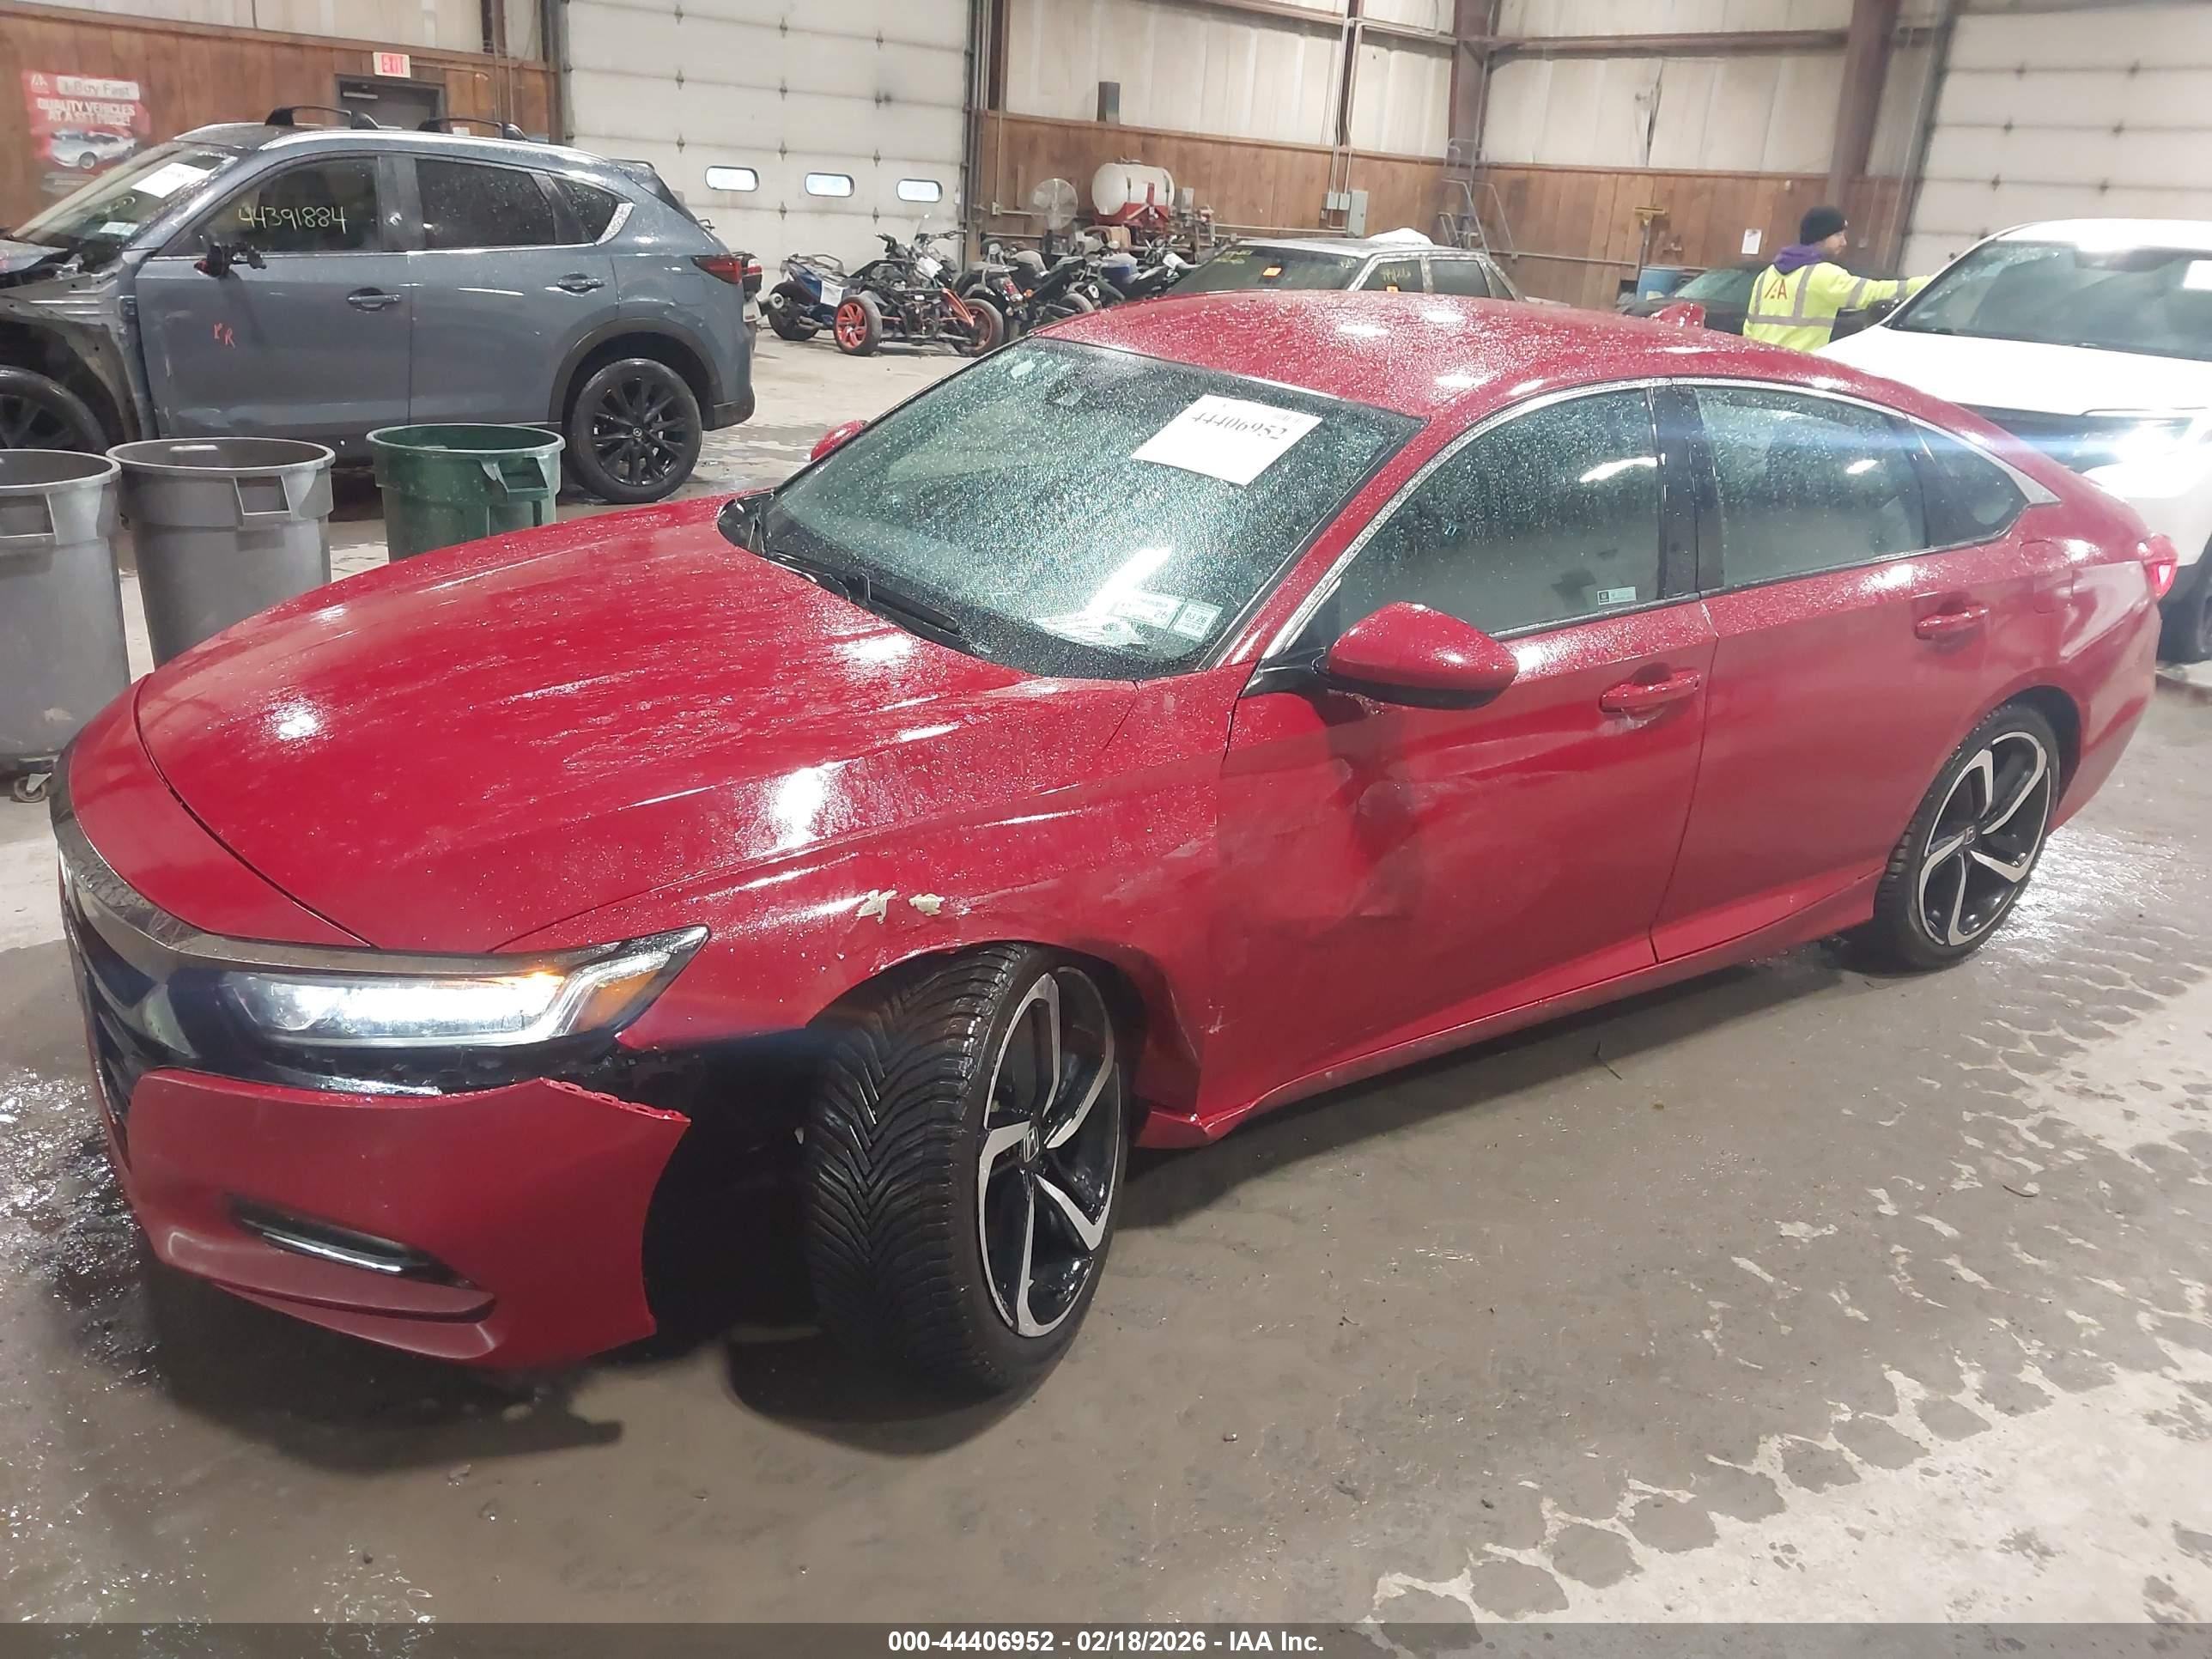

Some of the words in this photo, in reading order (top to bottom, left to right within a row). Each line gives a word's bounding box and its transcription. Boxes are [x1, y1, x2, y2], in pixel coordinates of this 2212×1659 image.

[381, 53, 404, 75] EXIT
[37, 97, 83, 112] QUALITY
[83, 100, 136, 117] VEHICLES
[239, 206, 347, 234] 44391884
[1191, 411, 1288, 441] 44406952
